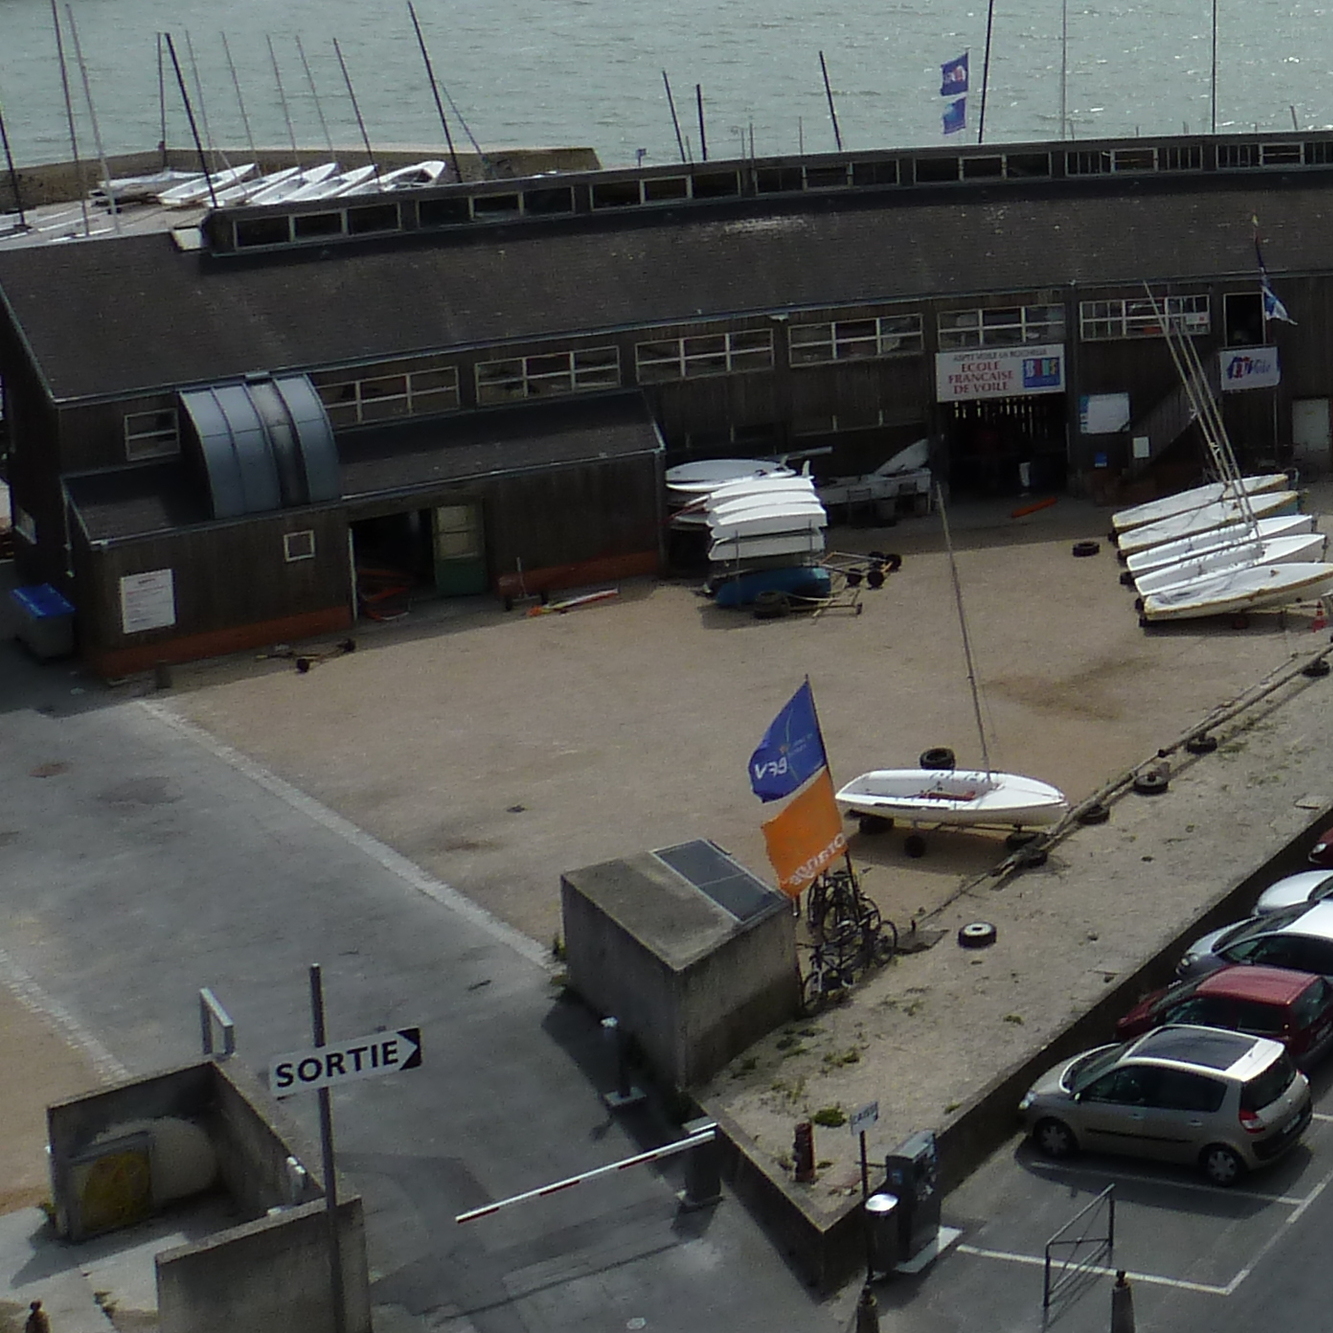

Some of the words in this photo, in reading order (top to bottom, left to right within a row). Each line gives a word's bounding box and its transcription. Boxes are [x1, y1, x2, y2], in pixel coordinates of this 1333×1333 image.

[961, 361, 1000, 373] ECOLE
[954, 384, 969, 395] DE
[973, 381, 1009, 393] VOILE
[276, 1040, 399, 1088] SORTIE
